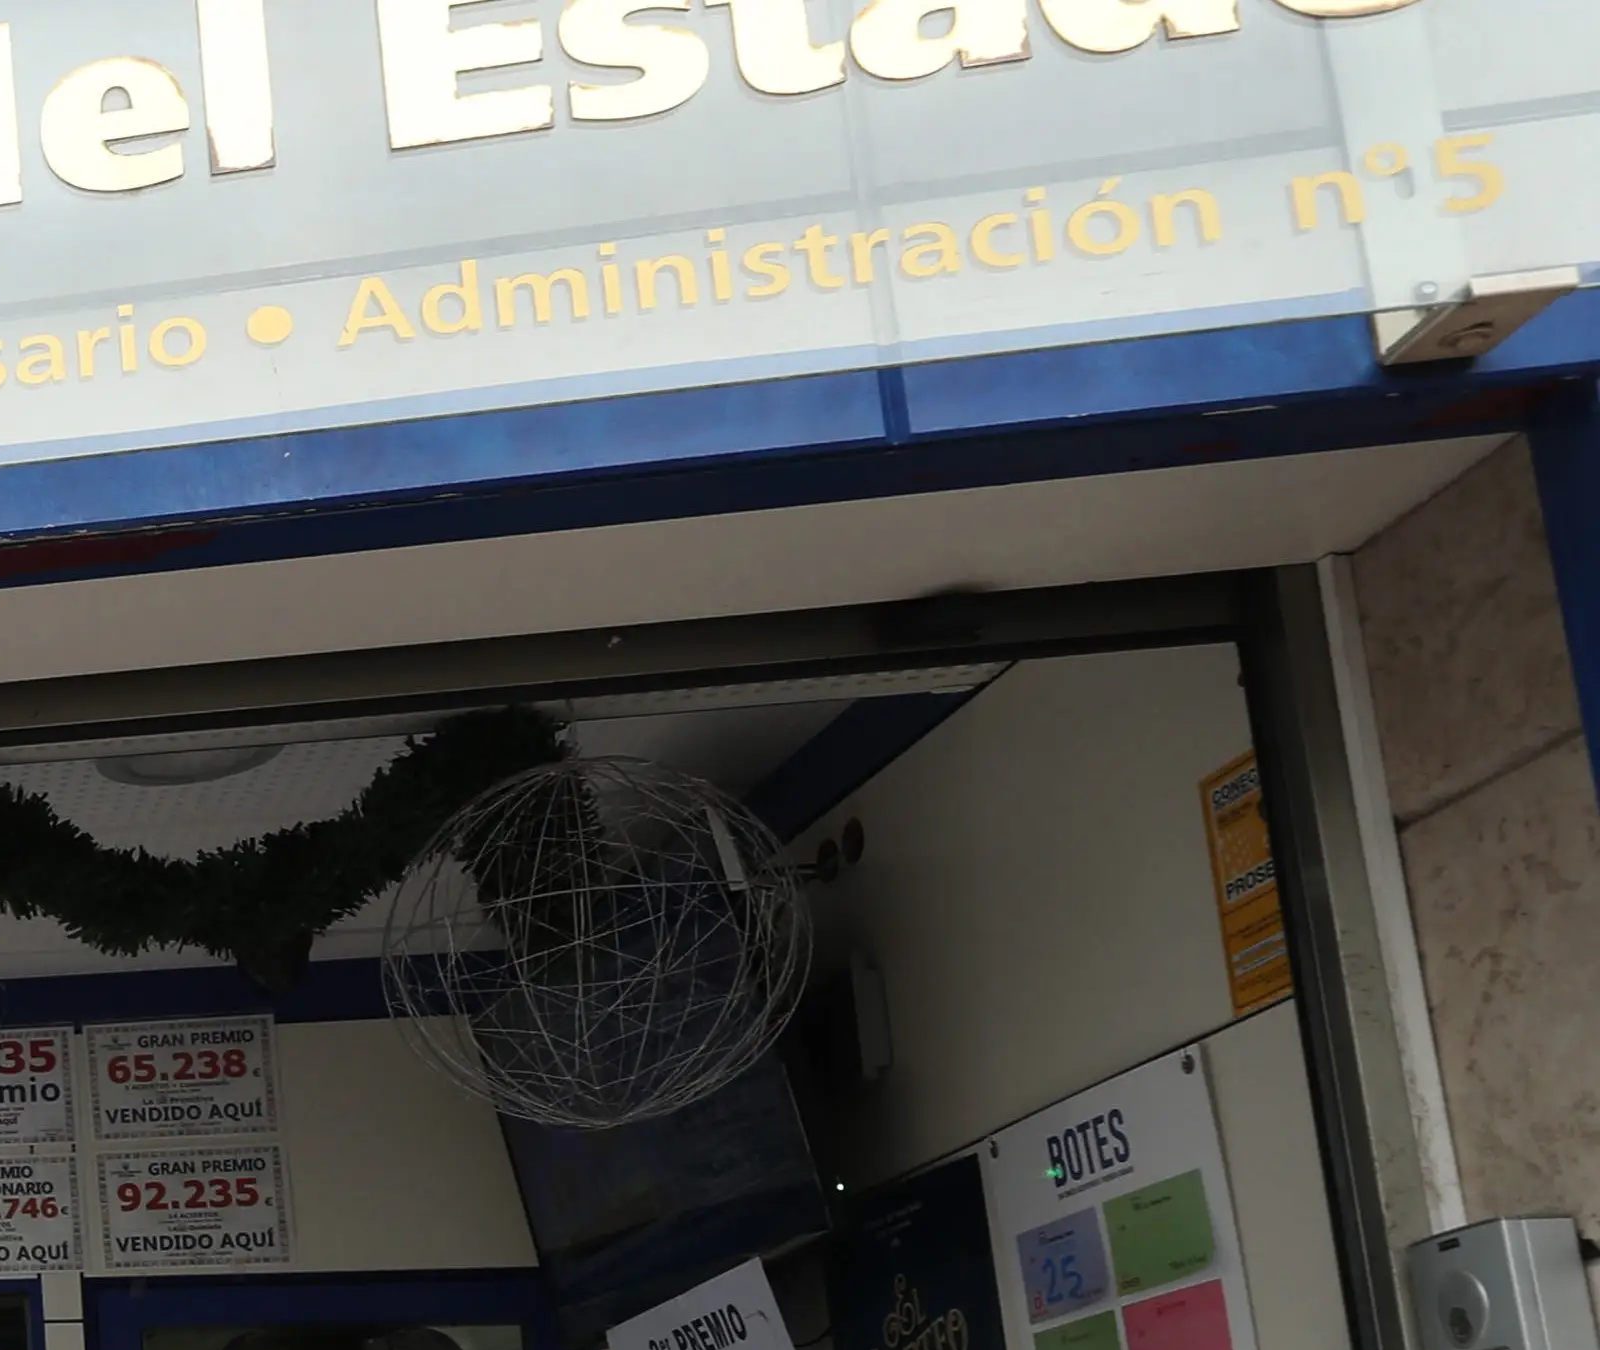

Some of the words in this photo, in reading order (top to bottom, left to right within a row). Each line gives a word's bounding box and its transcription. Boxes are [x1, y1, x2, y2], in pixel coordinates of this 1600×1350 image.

[378, 0, 1406, 152] Esta
[338, 176, 1223, 347] Administración
[137, 1032, 185, 1049] GRAN
[190, 1029, 254, 1045] PREMIO
[104, 1105, 202, 1125] VENDIDO
[208, 1099, 264, 1121] AQUÍ
[1046, 1108, 1131, 1188] BOTES
[147, 1161, 196, 1176] GRAN
[201, 1157, 266, 1173] PREMIO
[16, 1241, 69, 1263] AQUÍ
[116, 1234, 214, 1252] VENDIDO
[220, 1227, 276, 1250] AQUÍ
